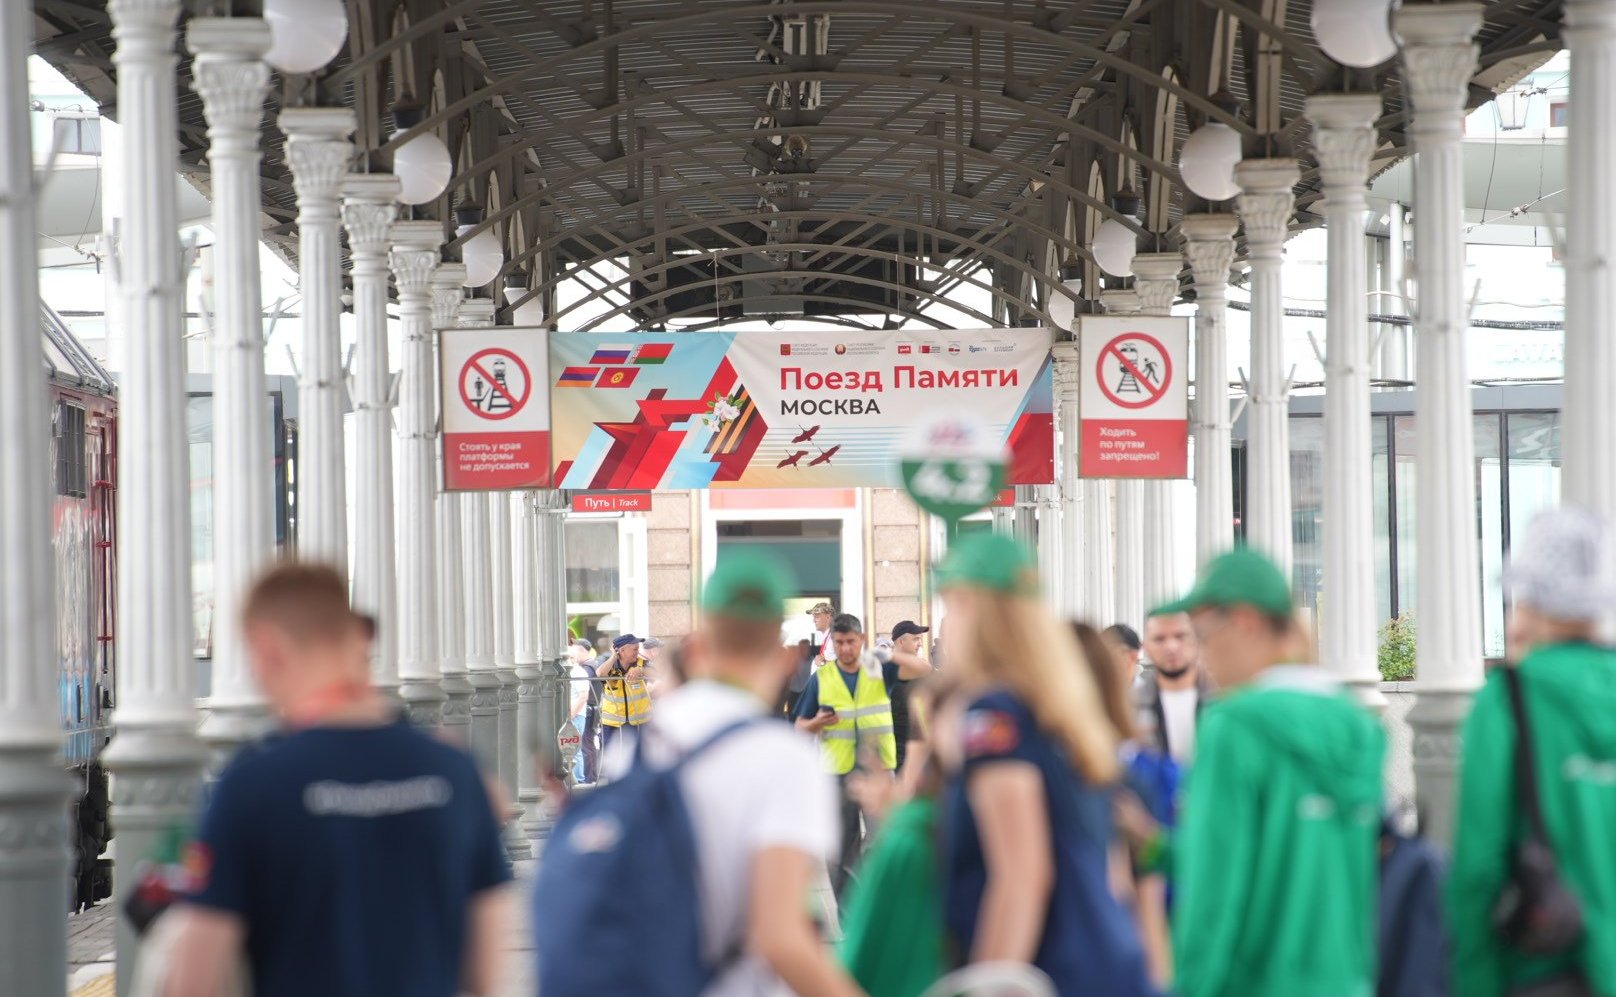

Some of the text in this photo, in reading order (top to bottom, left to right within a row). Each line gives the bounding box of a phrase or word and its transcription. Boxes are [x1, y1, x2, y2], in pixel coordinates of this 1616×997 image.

[780, 366, 1019, 392] Поезд Памяти
[780, 398, 882, 416] МОСКВА
[1099, 427, 1137, 437] Ходить
[459, 442, 522, 452] Стоять у края
[1099, 440, 1146, 451] по путям
[459, 453, 515, 463] платформы
[1100, 451, 1160, 463] запрещено!
[459, 462, 530, 472] не допускается
[585, 498, 639, 510] Путь Track
